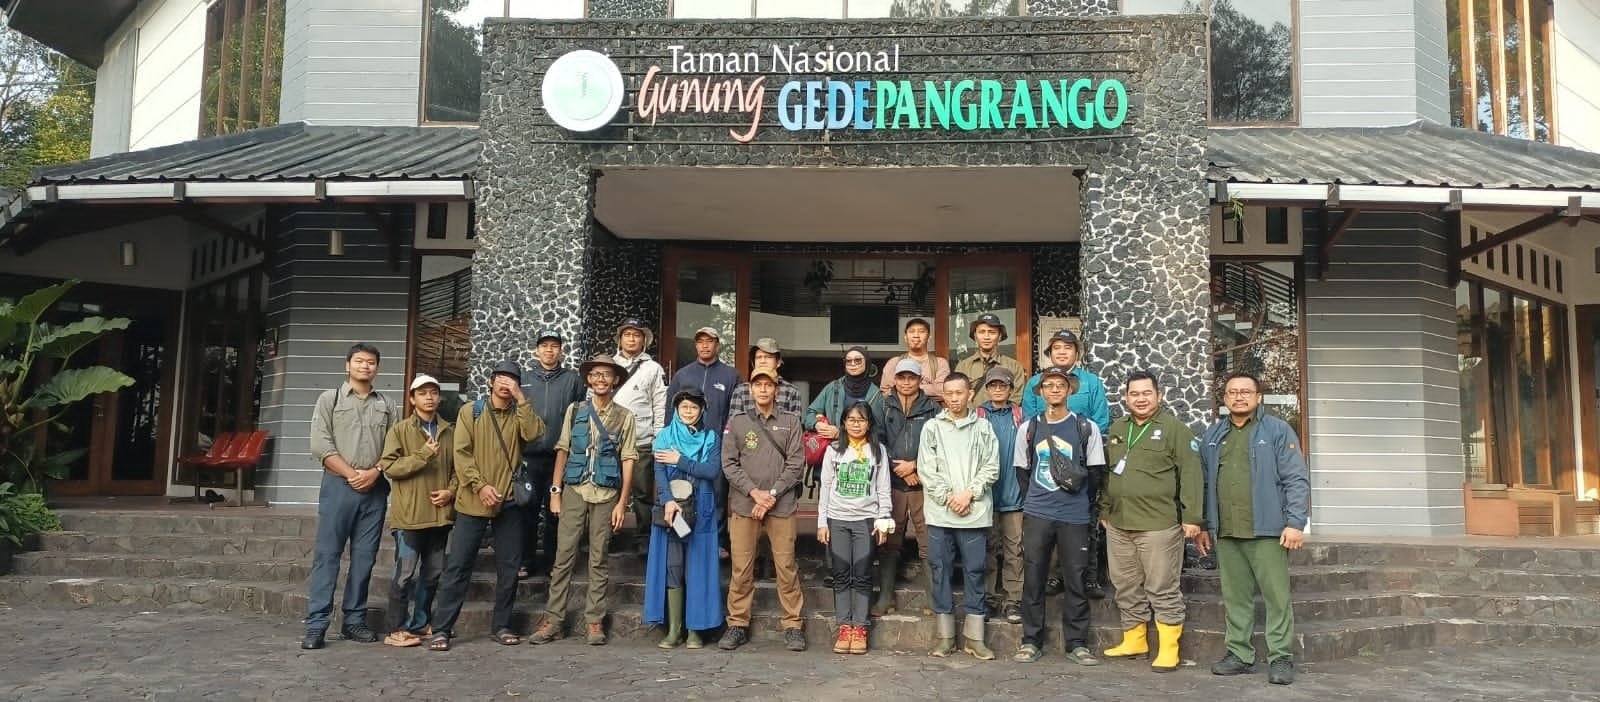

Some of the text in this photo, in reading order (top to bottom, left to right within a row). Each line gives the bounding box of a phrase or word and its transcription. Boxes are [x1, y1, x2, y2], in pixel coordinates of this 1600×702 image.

[667, 44, 900, 74] Taman Nasional
[638, 65, 766, 143] Gunung
